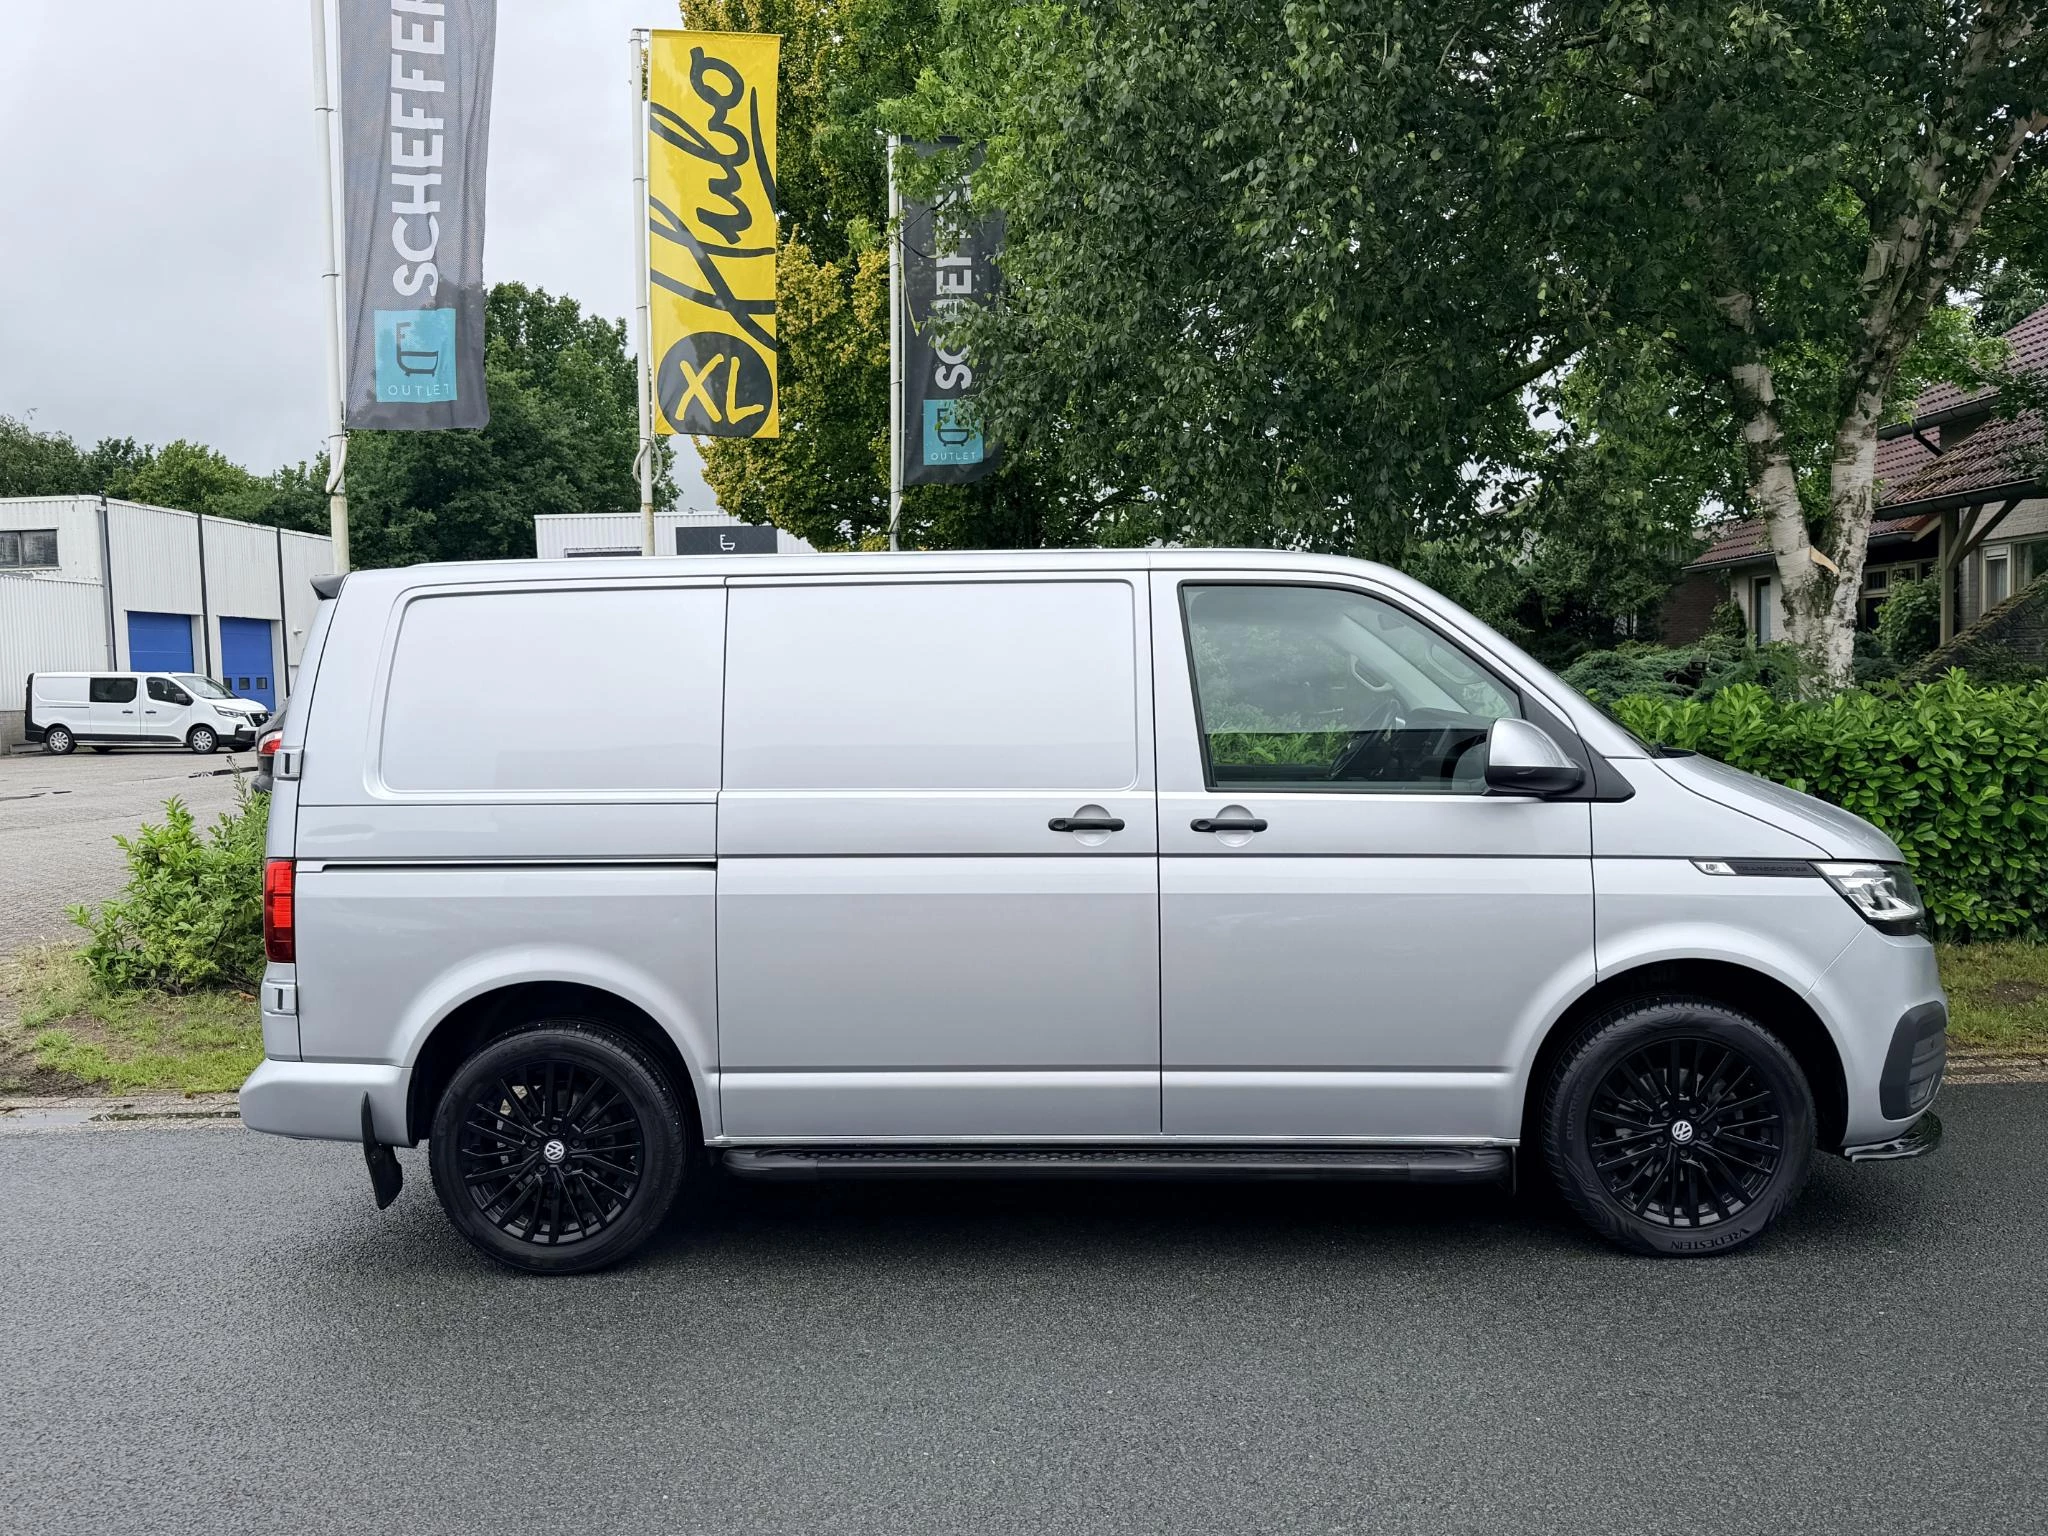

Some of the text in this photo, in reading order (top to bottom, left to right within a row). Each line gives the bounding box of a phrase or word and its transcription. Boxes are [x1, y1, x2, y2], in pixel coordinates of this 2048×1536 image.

[388, 383, 450, 397] OUTLET
[675, 353, 765, 424] XL
[930, 451, 976, 461] OUTLET
[1671, 1227, 1752, 1251] VREDESTEIN
